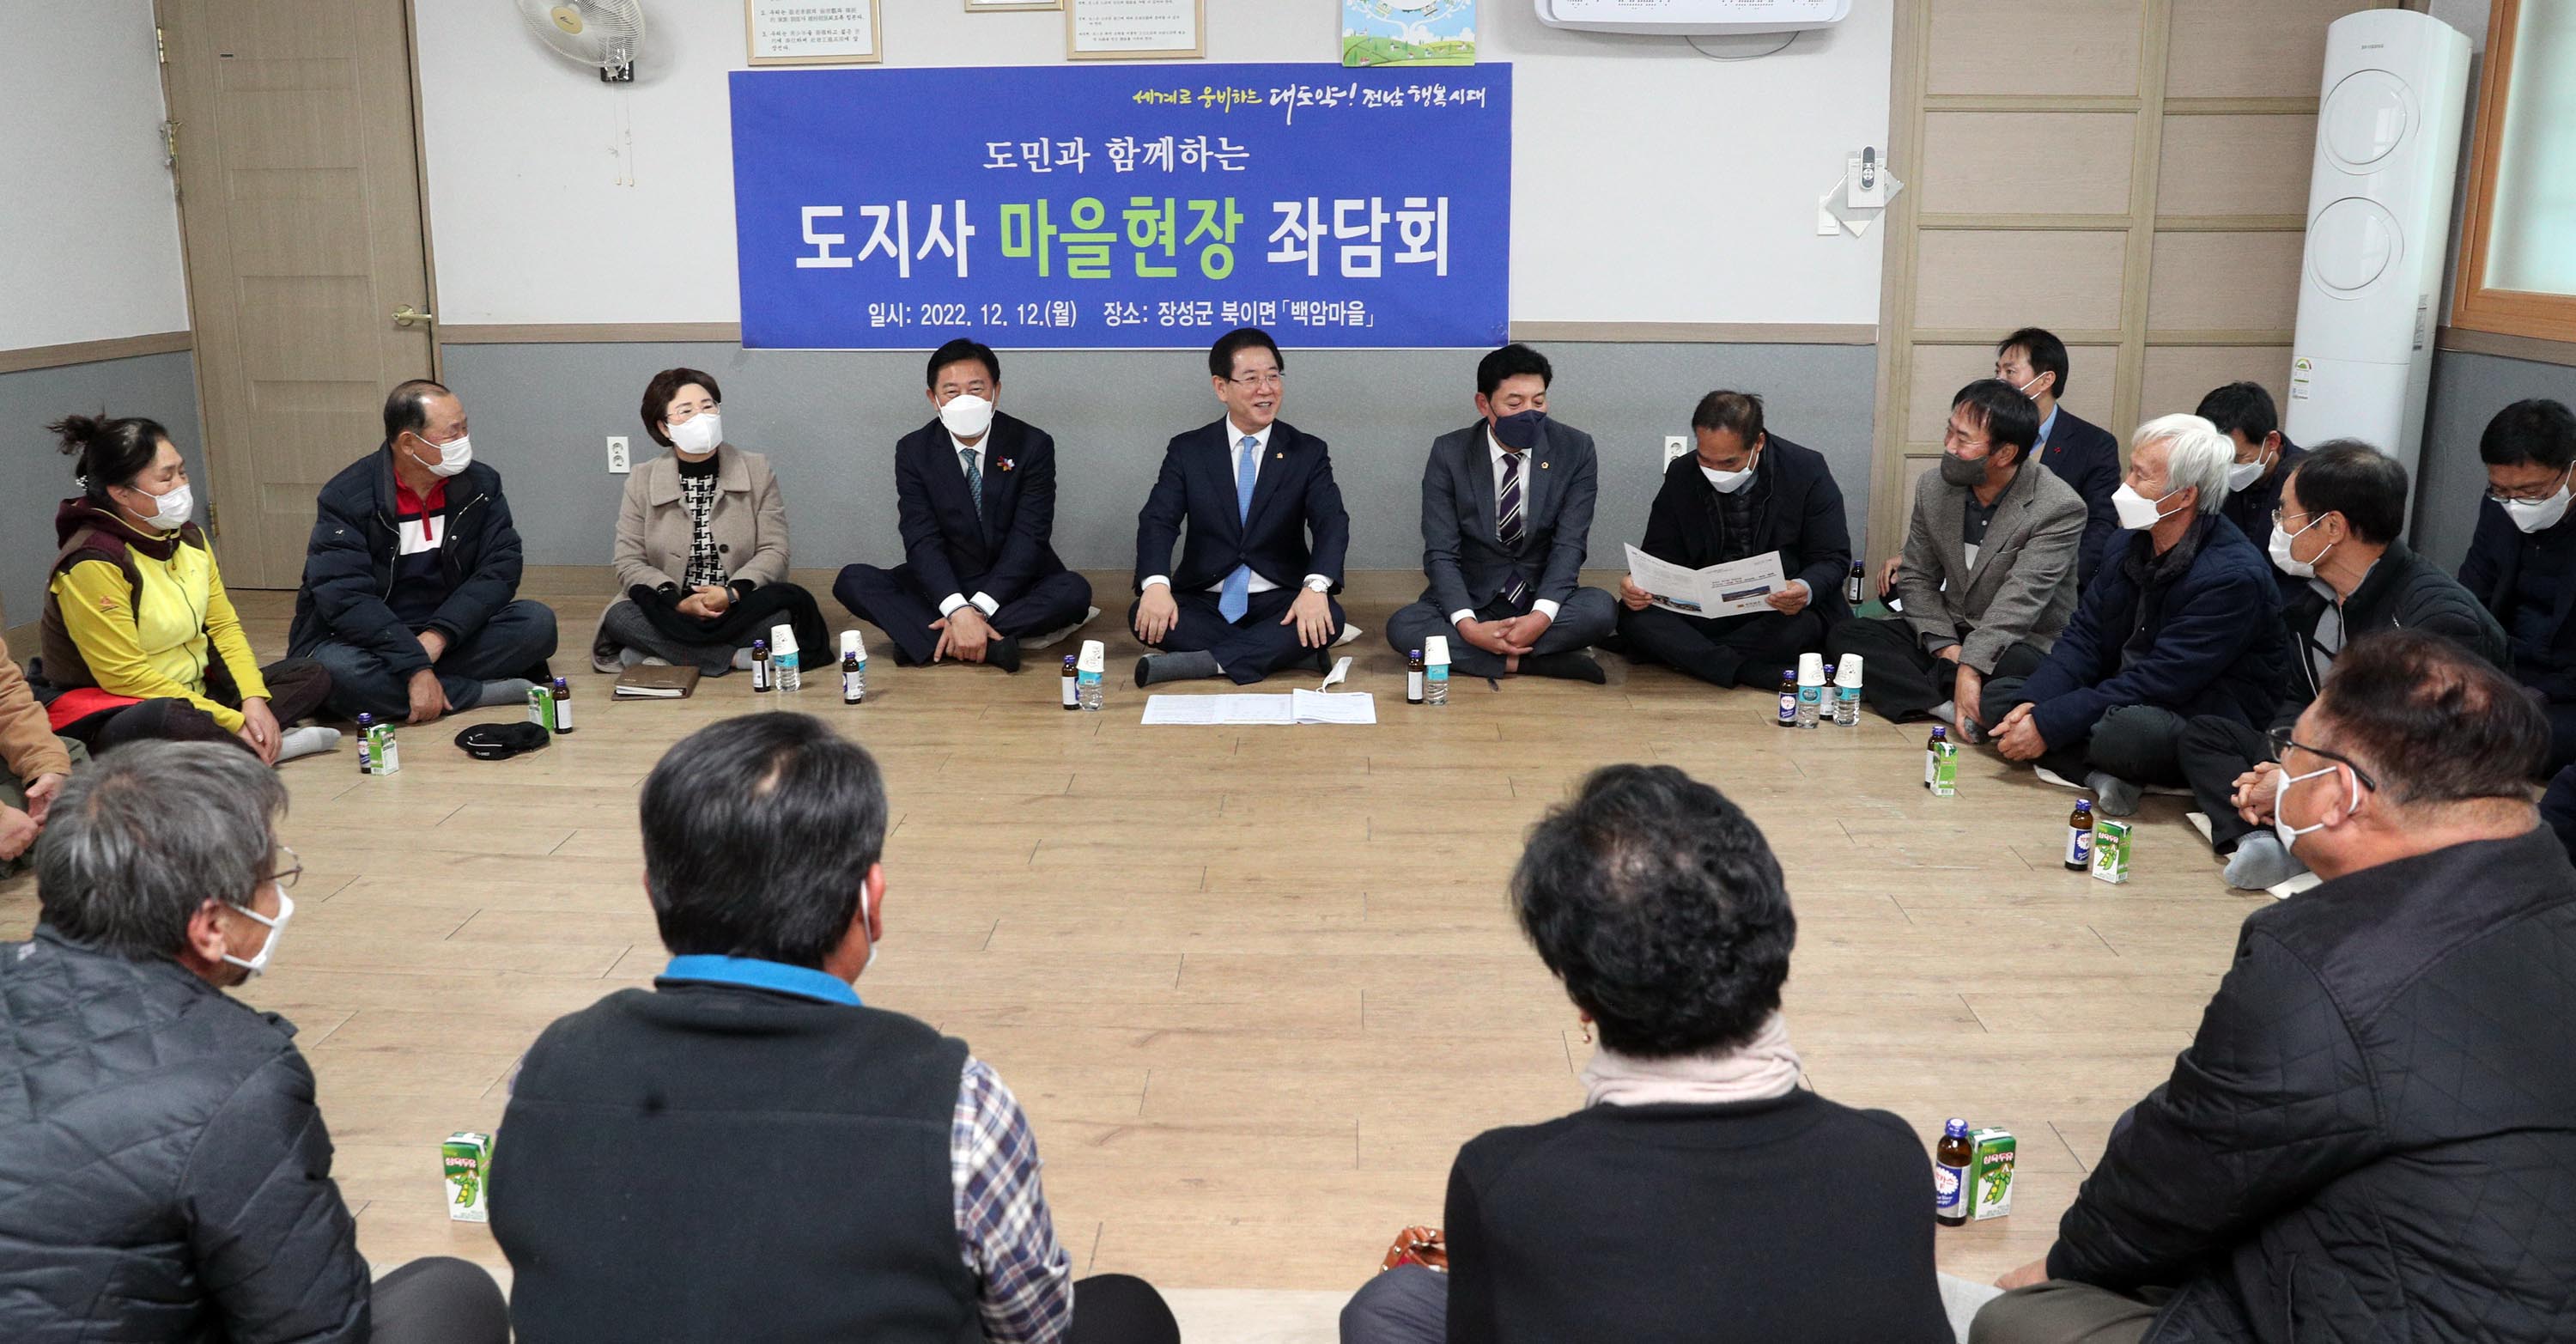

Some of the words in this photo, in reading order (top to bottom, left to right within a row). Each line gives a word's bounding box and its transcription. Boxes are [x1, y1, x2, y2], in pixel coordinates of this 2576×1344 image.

[1132, 88, 1193, 105] 세계로
[1196, 86, 1263, 114] 웅비하는
[1269, 82, 1358, 126] 대도약!
[1361, 85, 1405, 109] 전남
[982, 136, 1091, 174] 도민과
[1104, 135, 1250, 173] 함께하는
[795, 198, 976, 279] 도지사
[999, 196, 1244, 281] 마을현장
[1267, 196, 1449, 278] 좌담회
[867, 301, 912, 328] 일시:
[920, 303, 972, 327] 2022.
[980, 302, 1008, 326] 12.
[1103, 301, 1148, 327] 장소:
[1157, 300, 1214, 327] 장성군
